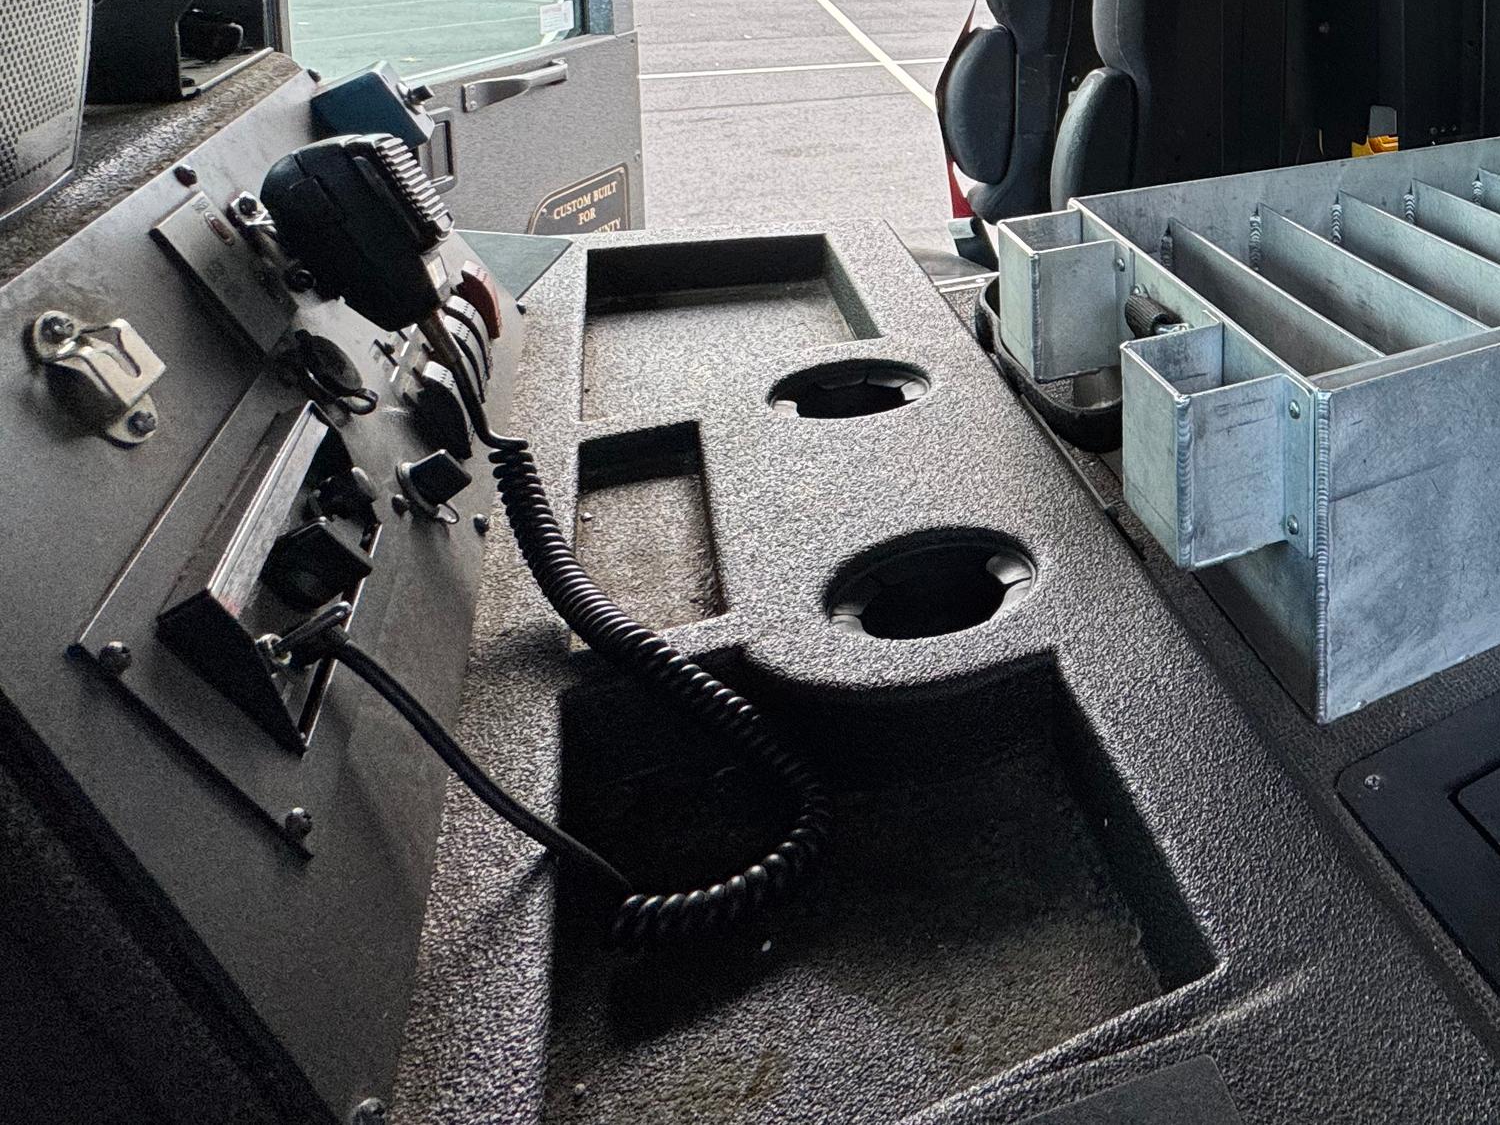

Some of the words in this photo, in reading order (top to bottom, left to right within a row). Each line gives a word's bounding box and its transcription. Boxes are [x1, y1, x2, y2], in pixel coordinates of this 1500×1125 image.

[553, 193, 592, 220] CUSTOM
[592, 181, 618, 203] BUILT
[577, 207, 597, 225] FOR
[593, 217, 621, 234] UNTY
